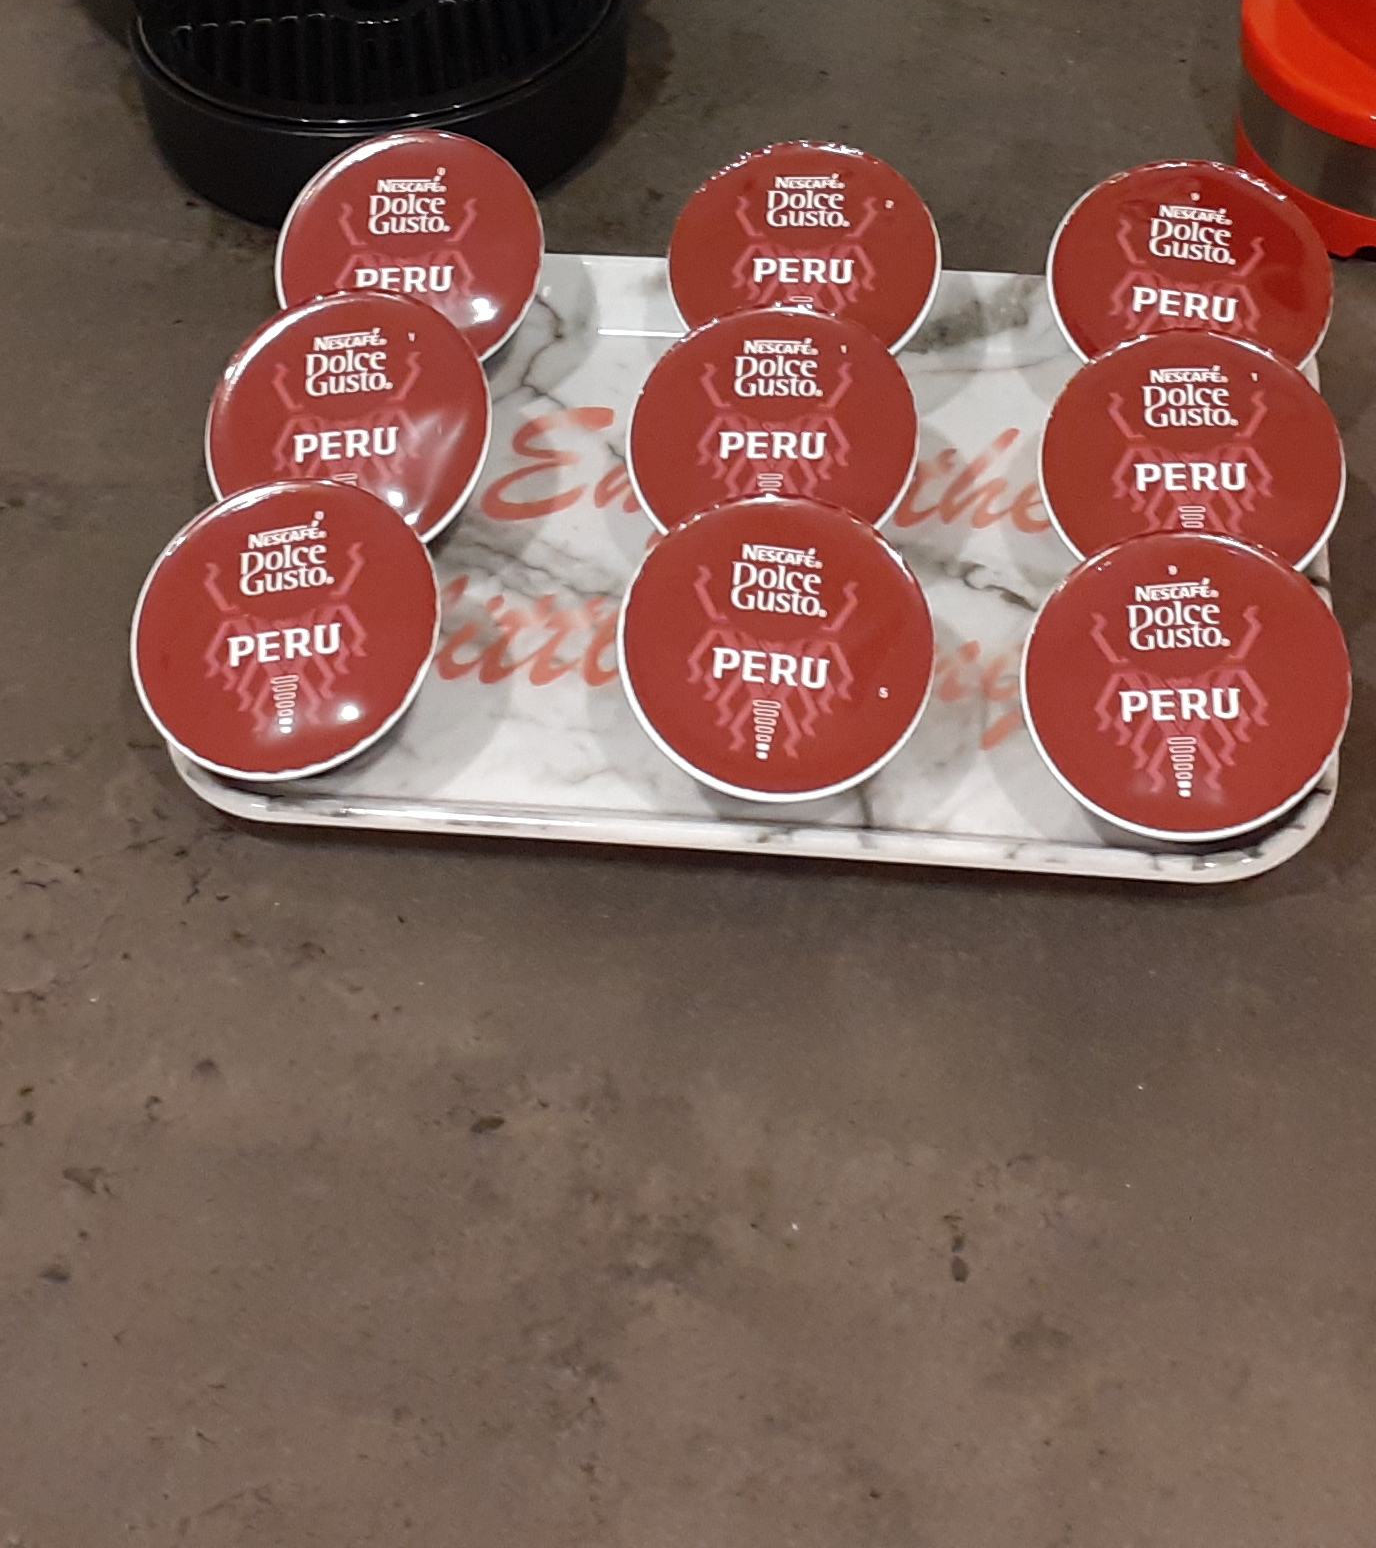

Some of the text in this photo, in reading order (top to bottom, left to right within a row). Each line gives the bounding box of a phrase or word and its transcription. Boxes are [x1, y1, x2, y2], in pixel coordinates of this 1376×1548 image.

[368, 193, 447, 216] Dolce
[765, 188, 845, 212] Dolce
[1150, 218, 1232, 247] Dolce
[353, 265, 455, 293] PERU
[752, 256, 854, 285] PERU
[1132, 285, 1239, 324] PERU
[305, 348, 387, 378] Dolce
[734, 354, 818, 381] Dolce
[1142, 383, 1229, 413] Dolce
[293, 425, 400, 463] PERU
[718, 429, 827, 461] PERU
[1135, 461, 1248, 492] PERU
[239, 544, 327, 575] Dolce
[731, 561, 821, 594] Dolce
[1126, 601, 1221, 629] Dolce
[227, 622, 342, 667] PERU
[712, 646, 832, 691] PERU
[1119, 687, 1240, 723] PERU
